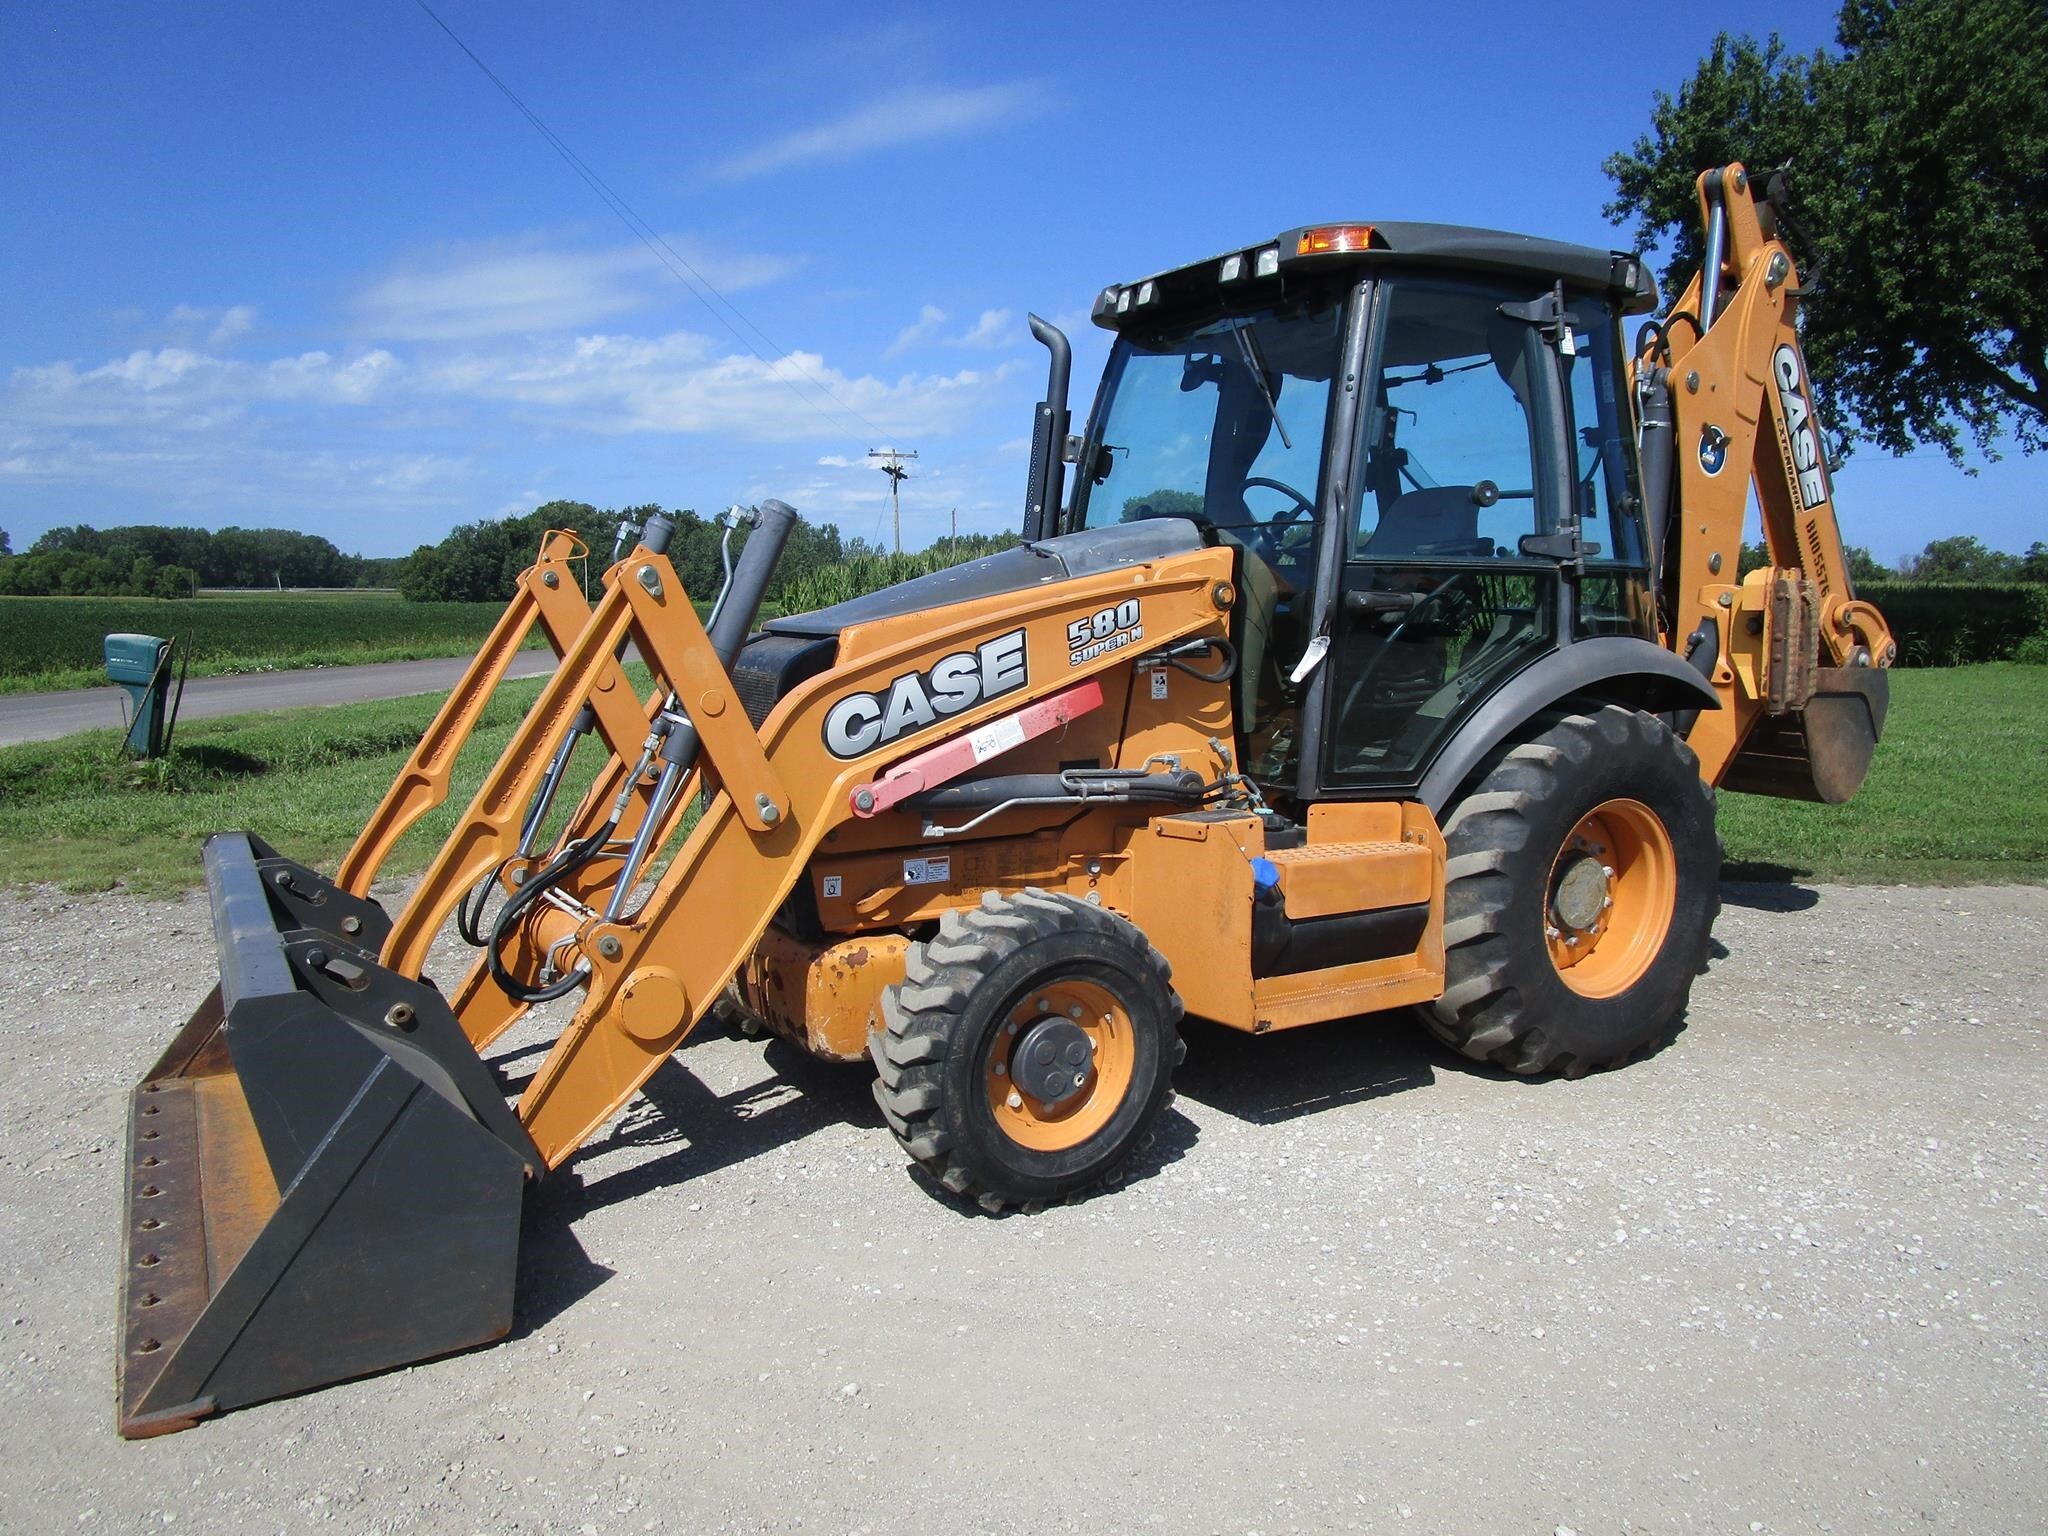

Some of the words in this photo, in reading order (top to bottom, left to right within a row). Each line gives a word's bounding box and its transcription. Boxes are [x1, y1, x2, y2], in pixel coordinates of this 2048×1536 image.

[1774, 344, 1826, 509] CASE
[1067, 598, 1140, 651] 580
[1069, 632, 1128, 666] SUPER
[1130, 625, 1143, 642] N
[823, 628, 1028, 759] CASE
